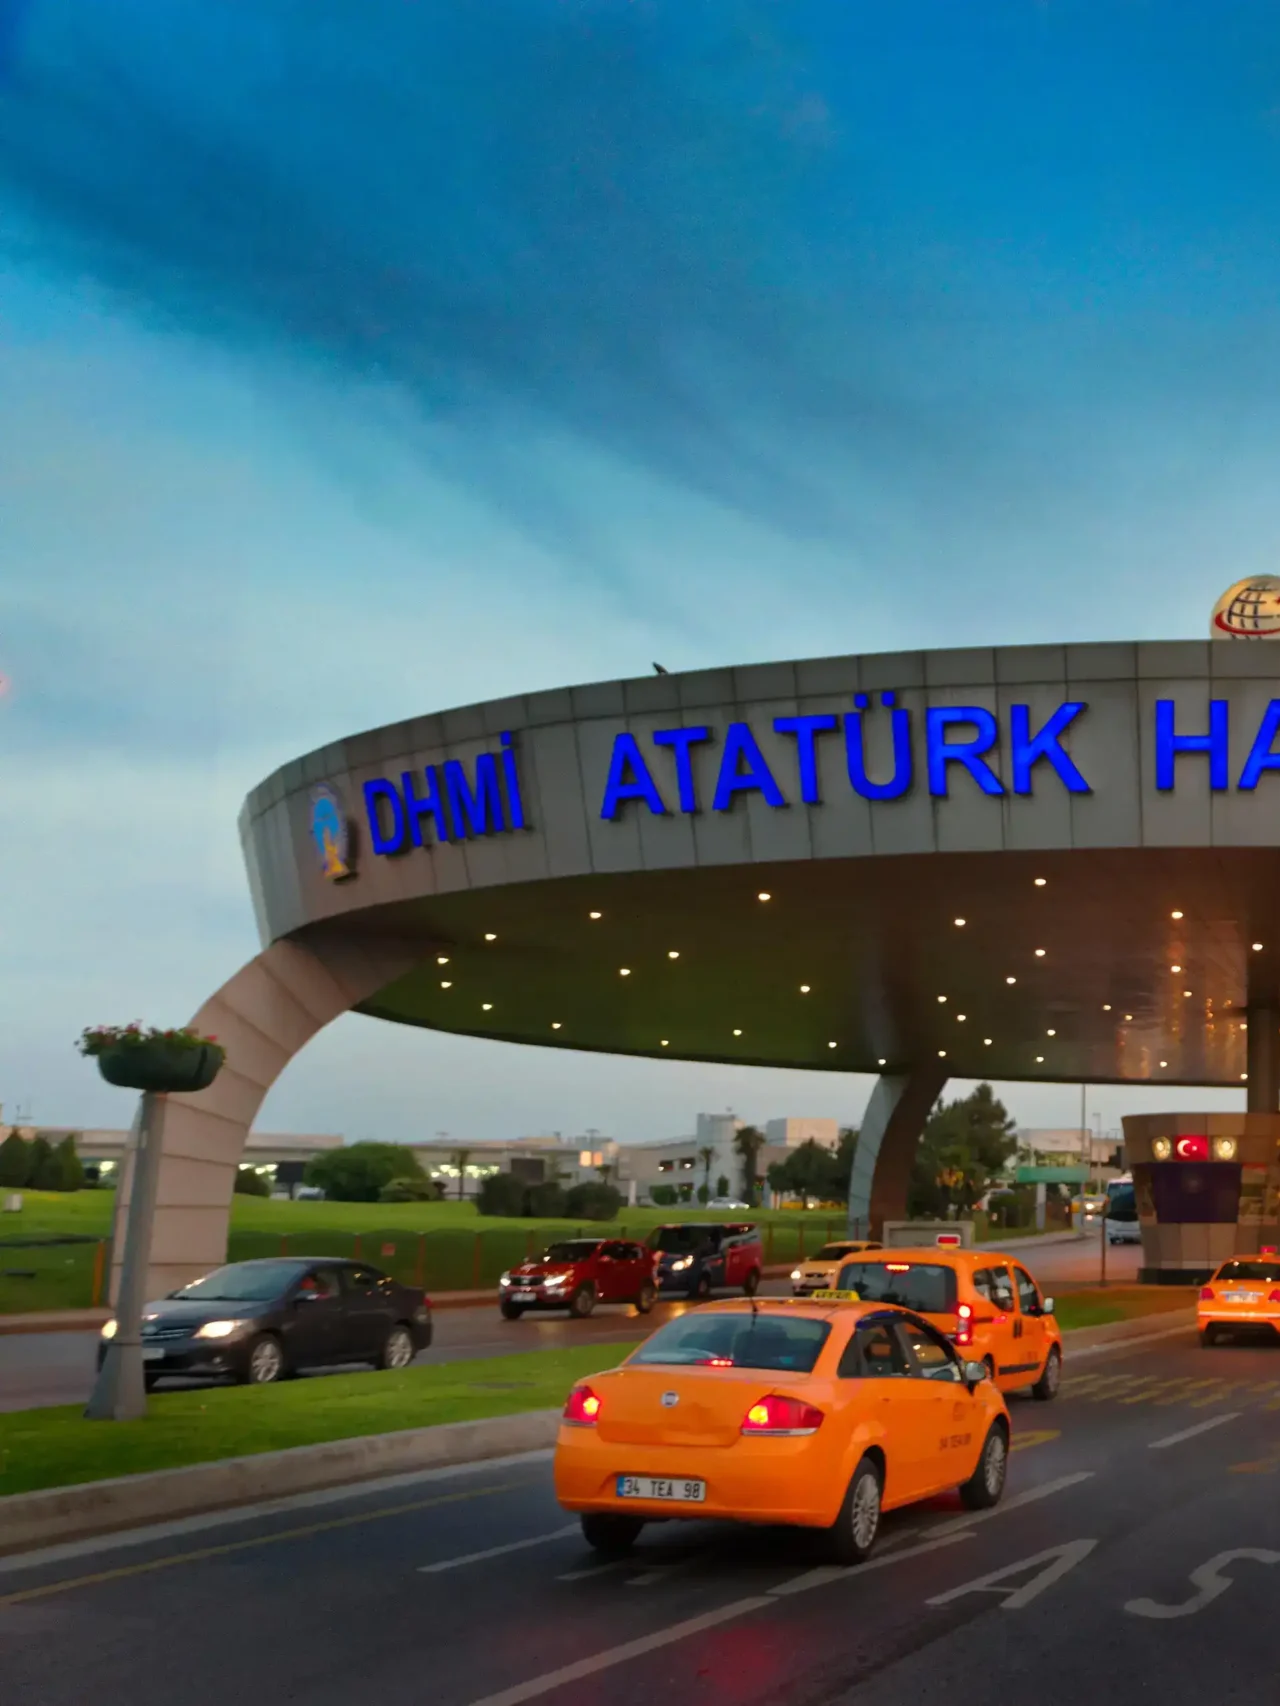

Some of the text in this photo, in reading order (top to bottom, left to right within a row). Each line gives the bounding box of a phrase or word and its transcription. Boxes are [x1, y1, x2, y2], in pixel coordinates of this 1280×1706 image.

[363, 731, 525, 857] DHMİ
[601, 691, 1090, 820] ATATÜRK
[624, 1478, 701, 1499] 34 TEA 98
